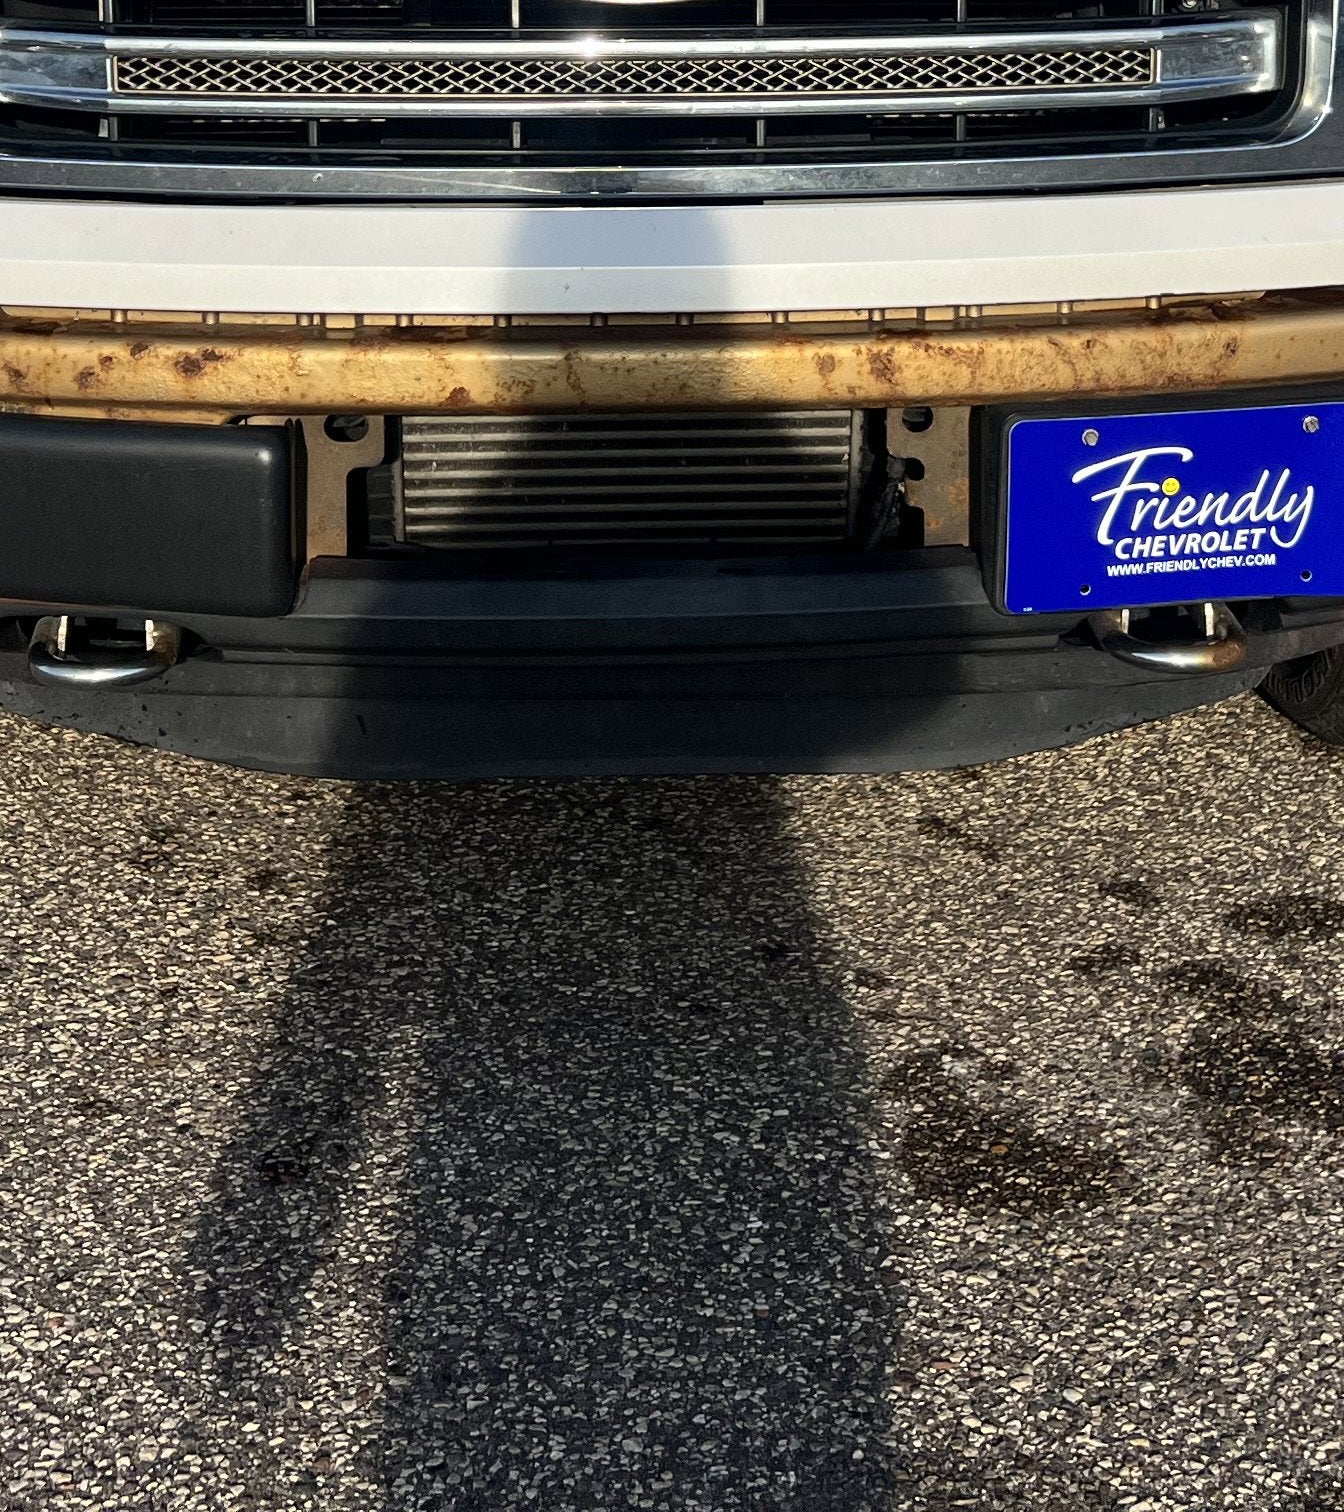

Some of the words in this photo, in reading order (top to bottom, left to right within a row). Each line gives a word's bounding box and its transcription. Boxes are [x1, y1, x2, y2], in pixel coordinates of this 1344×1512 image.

[1071, 445, 1315, 549] Friendly
[1114, 526, 1269, 561] CHEVROLET
[1106, 553, 1276, 577] WWW.FRIENDLYCHEV.COM
